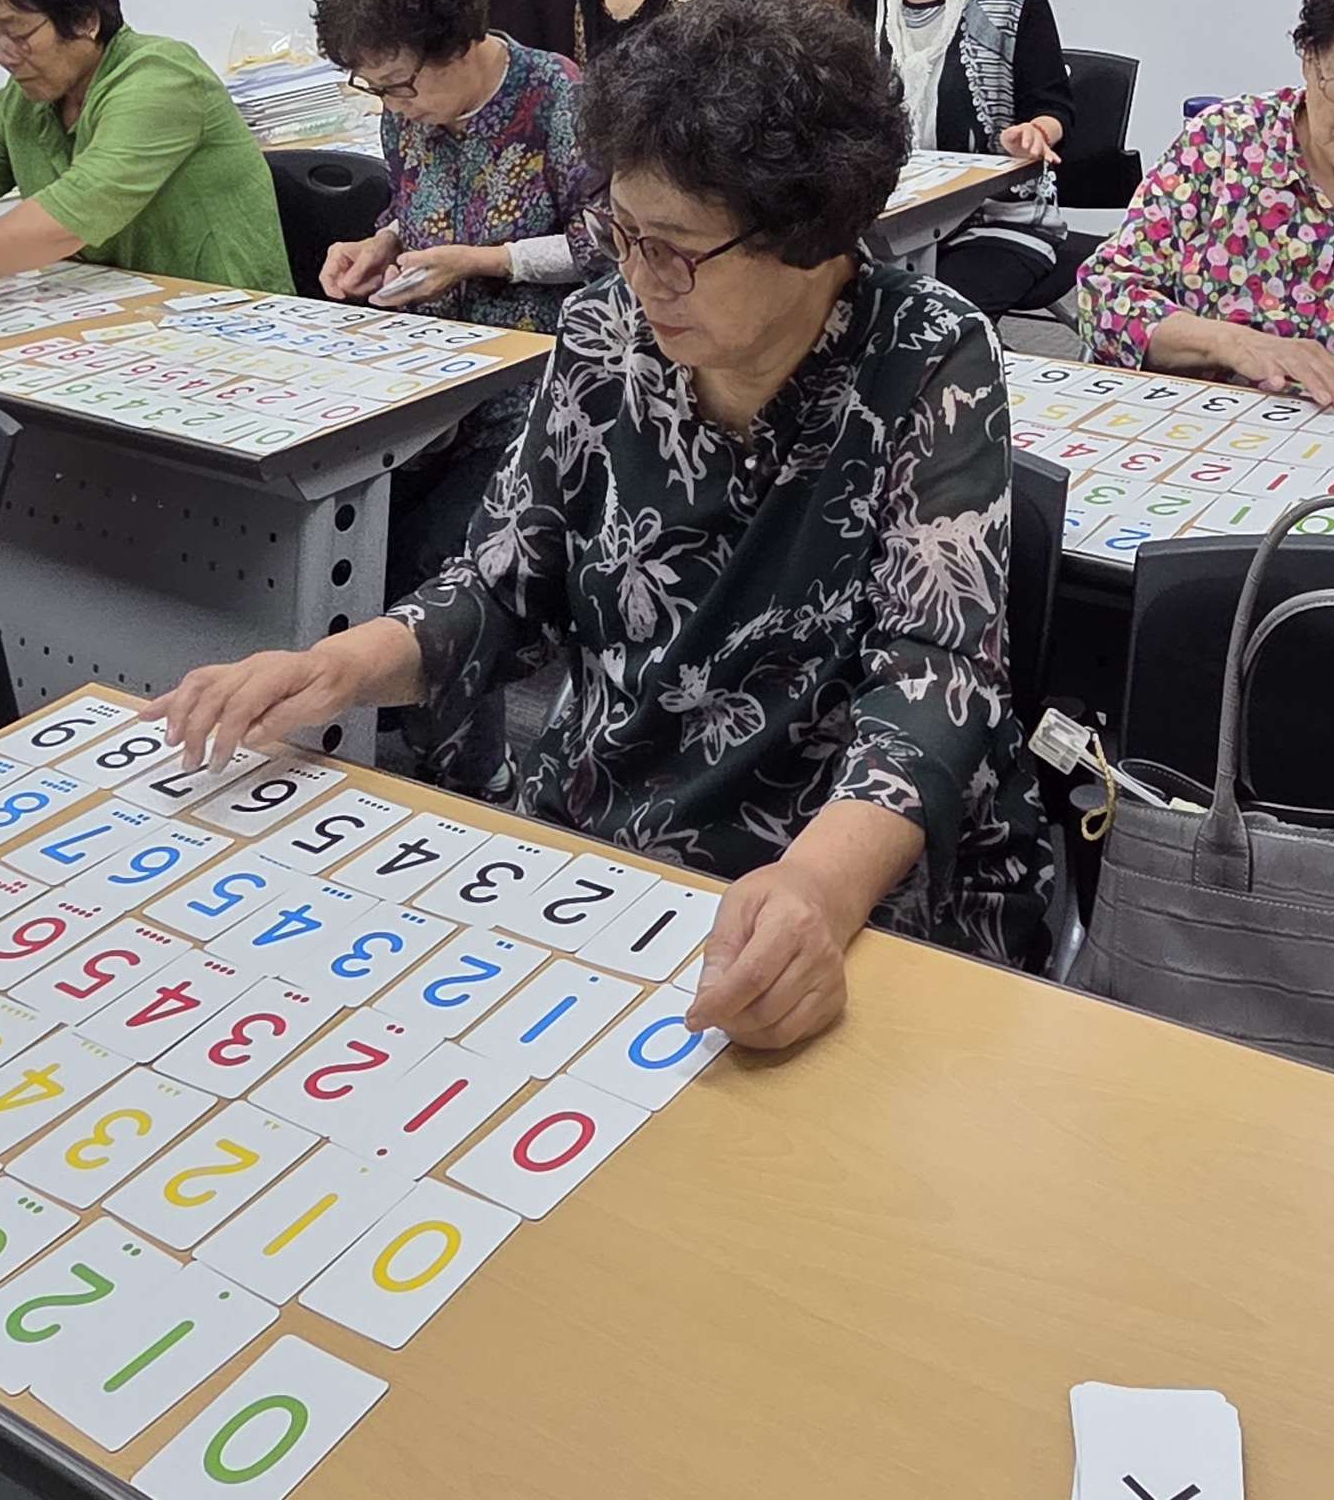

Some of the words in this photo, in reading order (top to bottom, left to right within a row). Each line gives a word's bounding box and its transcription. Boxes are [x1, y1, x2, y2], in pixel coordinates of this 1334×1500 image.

[1083, 380, 1123, 395] 5
[1143, 387, 1179, 399] 4
[1202, 397, 1239, 412] 3
[1038, 405, 1077, 420] 5
[1107, 413, 1142, 427] 4
[1165, 424, 1203, 440] 3
[1262, 404, 1301, 421] 2
[1059, 443, 1098, 458] 4
[1121, 454, 1161, 471] 3
[1229, 433, 1269, 450] 2
[1191, 463, 1232, 481] 2
[1084, 486, 1125, 504] 3
[1146, 496, 1191, 515] 2
[96, 737, 162, 769] 8
[40, 826, 112, 864] 7
[291, 815, 365, 854] 5
[376, 838, 440, 875] 4
[187, 873, 266, 917] 5
[460, 862, 524, 903] 3
[543, 879, 614, 924] 2
[252, 905, 322, 946] 4
[631, 910, 677, 952] 1
[54, 950, 140, 999] 5
[331, 932, 403, 978] 3
[423, 955, 501, 1007] 2
[126, 981, 201, 1027] 4
[520, 996, 577, 1043] 1
[208, 1013, 286, 1066] 3
[628, 1016, 704, 1070] 0
[304, 1041, 389, 1100] 2
[403, 1079, 468, 1132] 1
[65, 1110, 152, 1169] 3
[513, 1112, 595, 1172] 0
[164, 1139, 259, 1207] 2
[263, 1194, 338, 1256] 1
[372, 1221, 461, 1292] 0
[6, 1263, 114, 1342] 2
[104, 1321, 194, 1392] 1
[204, 1395, 308, 1484] 0
